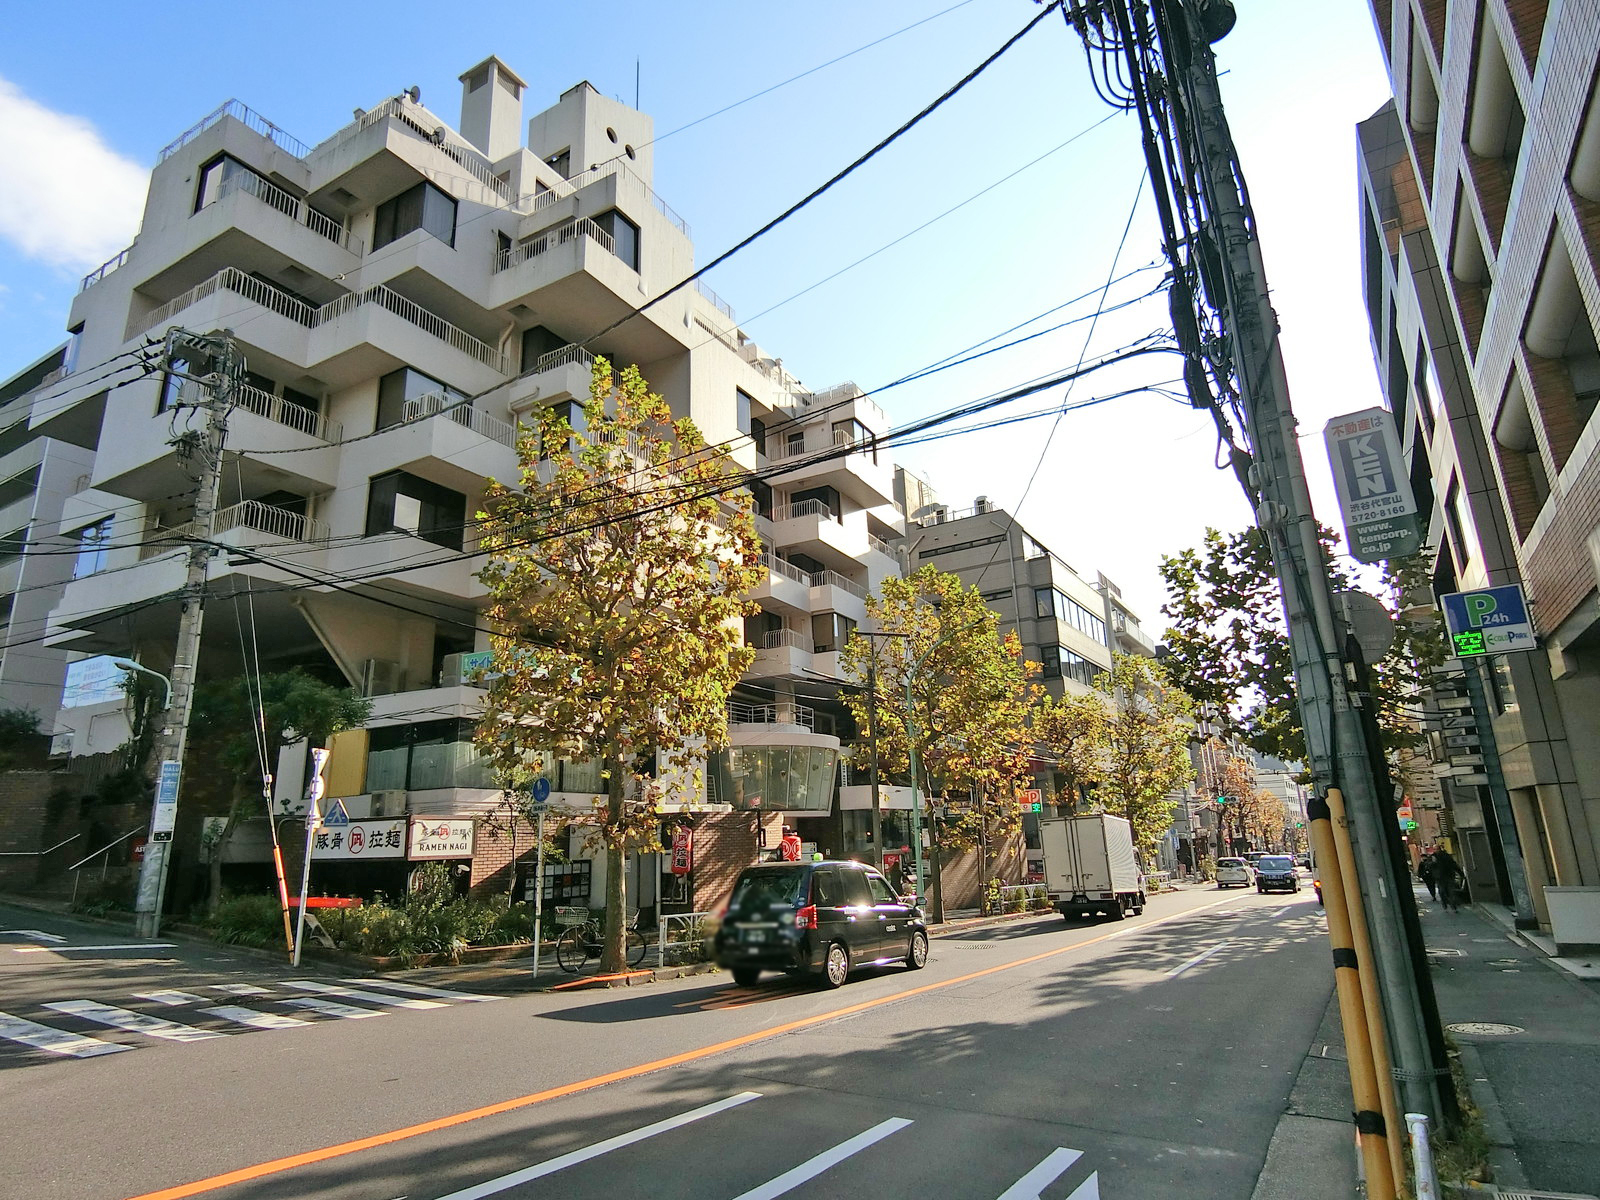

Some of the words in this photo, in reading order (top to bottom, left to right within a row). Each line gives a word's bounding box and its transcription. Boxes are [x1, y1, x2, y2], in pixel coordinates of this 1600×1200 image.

[1331, 416, 1383, 437] 不動産は
[1348, 434, 1387, 498] KEN
[1349, 495, 1402, 512] 渋谷代官山
[1352, 506, 1405, 522] 5720-8160
[1357, 522, 1392, 534] www.
[1359, 529, 1412, 544] kencorp.
[1362, 542, 1391, 553] co.jp
[1464, 594, 1497, 627] P
[1483, 613, 1509, 625] 24h
[1453, 631, 1485, 655] 空
[1028, 790, 1039, 803] P
[315, 832, 344, 850] 豚骨
[419, 843, 447, 852] RAMEN
[450, 842, 468, 851] NAGI
